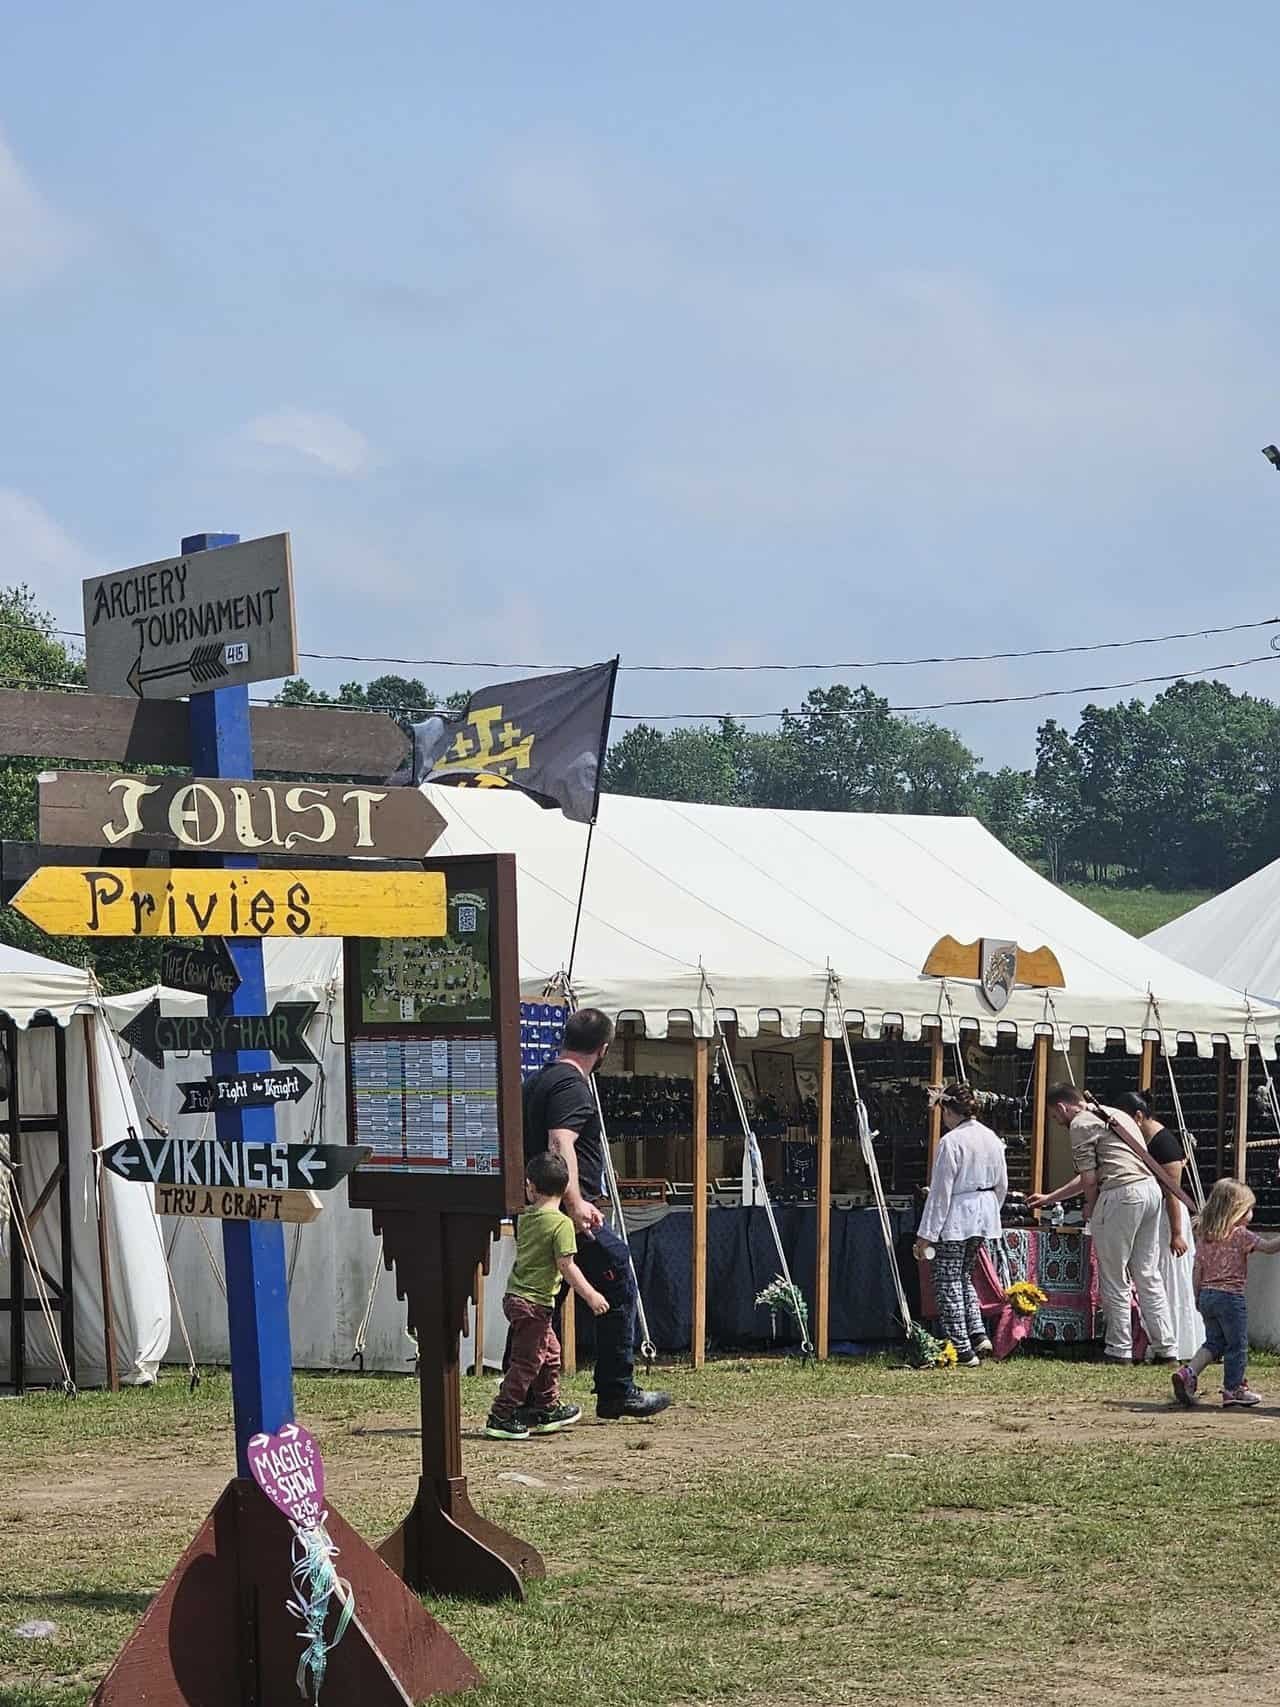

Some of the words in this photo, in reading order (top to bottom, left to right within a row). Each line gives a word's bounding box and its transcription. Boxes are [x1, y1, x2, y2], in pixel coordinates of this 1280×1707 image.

[93, 564, 189, 625] ARCHERY
[132, 588, 280, 647] TOURNAMENT
[227, 645, 243, 661] 45
[101, 778, 388, 850] JOUST
[80, 871, 312, 934] Privies
[155, 1017, 229, 1050] GYPSY
[239, 1015, 290, 1049] HAIR
[218, 1080, 248, 1103] Fight
[264, 1076, 300, 1099] Knight
[139, 1140, 288, 1189] VIKINGS
[160, 1189, 195, 1214] TRY
[199, 1191, 214, 1214] A
[221, 1191, 283, 1218] CRAFT
[254, 1441, 308, 1484] MAGIC
[277, 1466, 316, 1504] SHOW
